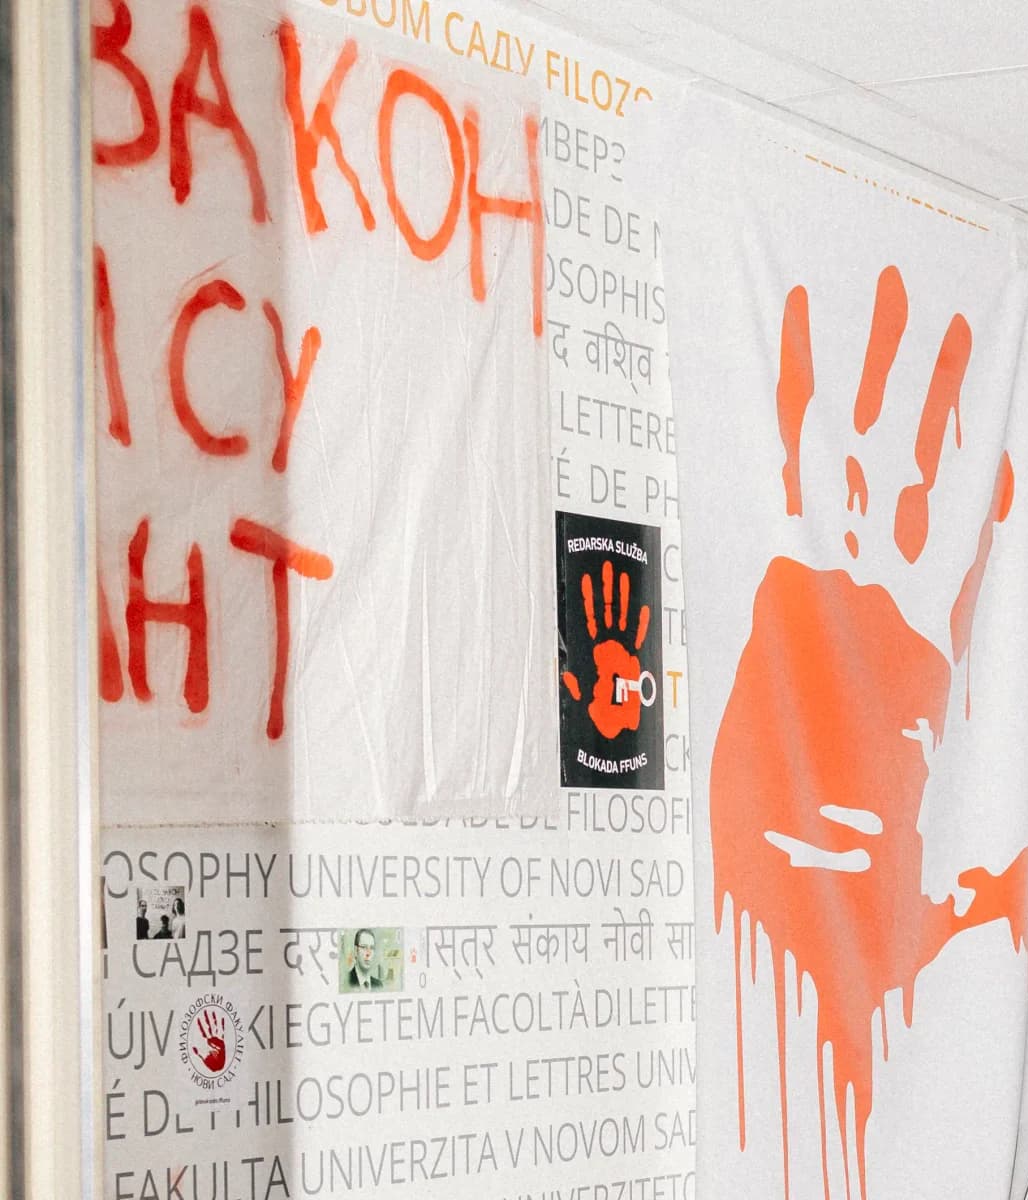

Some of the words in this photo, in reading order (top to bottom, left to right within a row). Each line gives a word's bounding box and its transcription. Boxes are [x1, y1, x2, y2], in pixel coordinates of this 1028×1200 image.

[445, 12, 535, 76] САДУ
[545, 187, 590, 237] DE
[604, 205, 640, 253] DE
[591, 464, 626, 509] DE
[567, 536, 614, 553] REDARSKA
[615, 541, 648, 565] SLUŽBA
[577, 749, 618, 774] BLOKADA
[619, 752, 648, 773] FFUNS
[567, 792, 690, 834] FILOSOFI
[289, 853, 491, 898] UNIVERSITY
[501, 857, 541, 897] OF
[550, 858, 621, 897] NOVI
[630, 859, 684, 897] SAD
[132, 930, 263, 987] САДЗЕ
[108, 998, 273, 1070] ÚJVKI
[287, 996, 443, 1048] EGYETEM
[454, 979, 588, 1036] FACOLTÀ
[595, 987, 620, 1028] DI
[179, 993, 223, 1064] ФИЛОЗОФСКИ
[225, 1001, 245, 1062] ФАКУЛТЕТ
[191, 1071, 214, 1090] НОВИ
[211, 1067, 450, 1131] HILOSOPHIE
[464, 1063, 498, 1105] ET
[509, 1053, 626, 1101] LETTRES
[301, 1131, 498, 1195] UNIVERZITA
[505, 1127, 524, 1168] V
[534, 1115, 645, 1166] NOVOM
